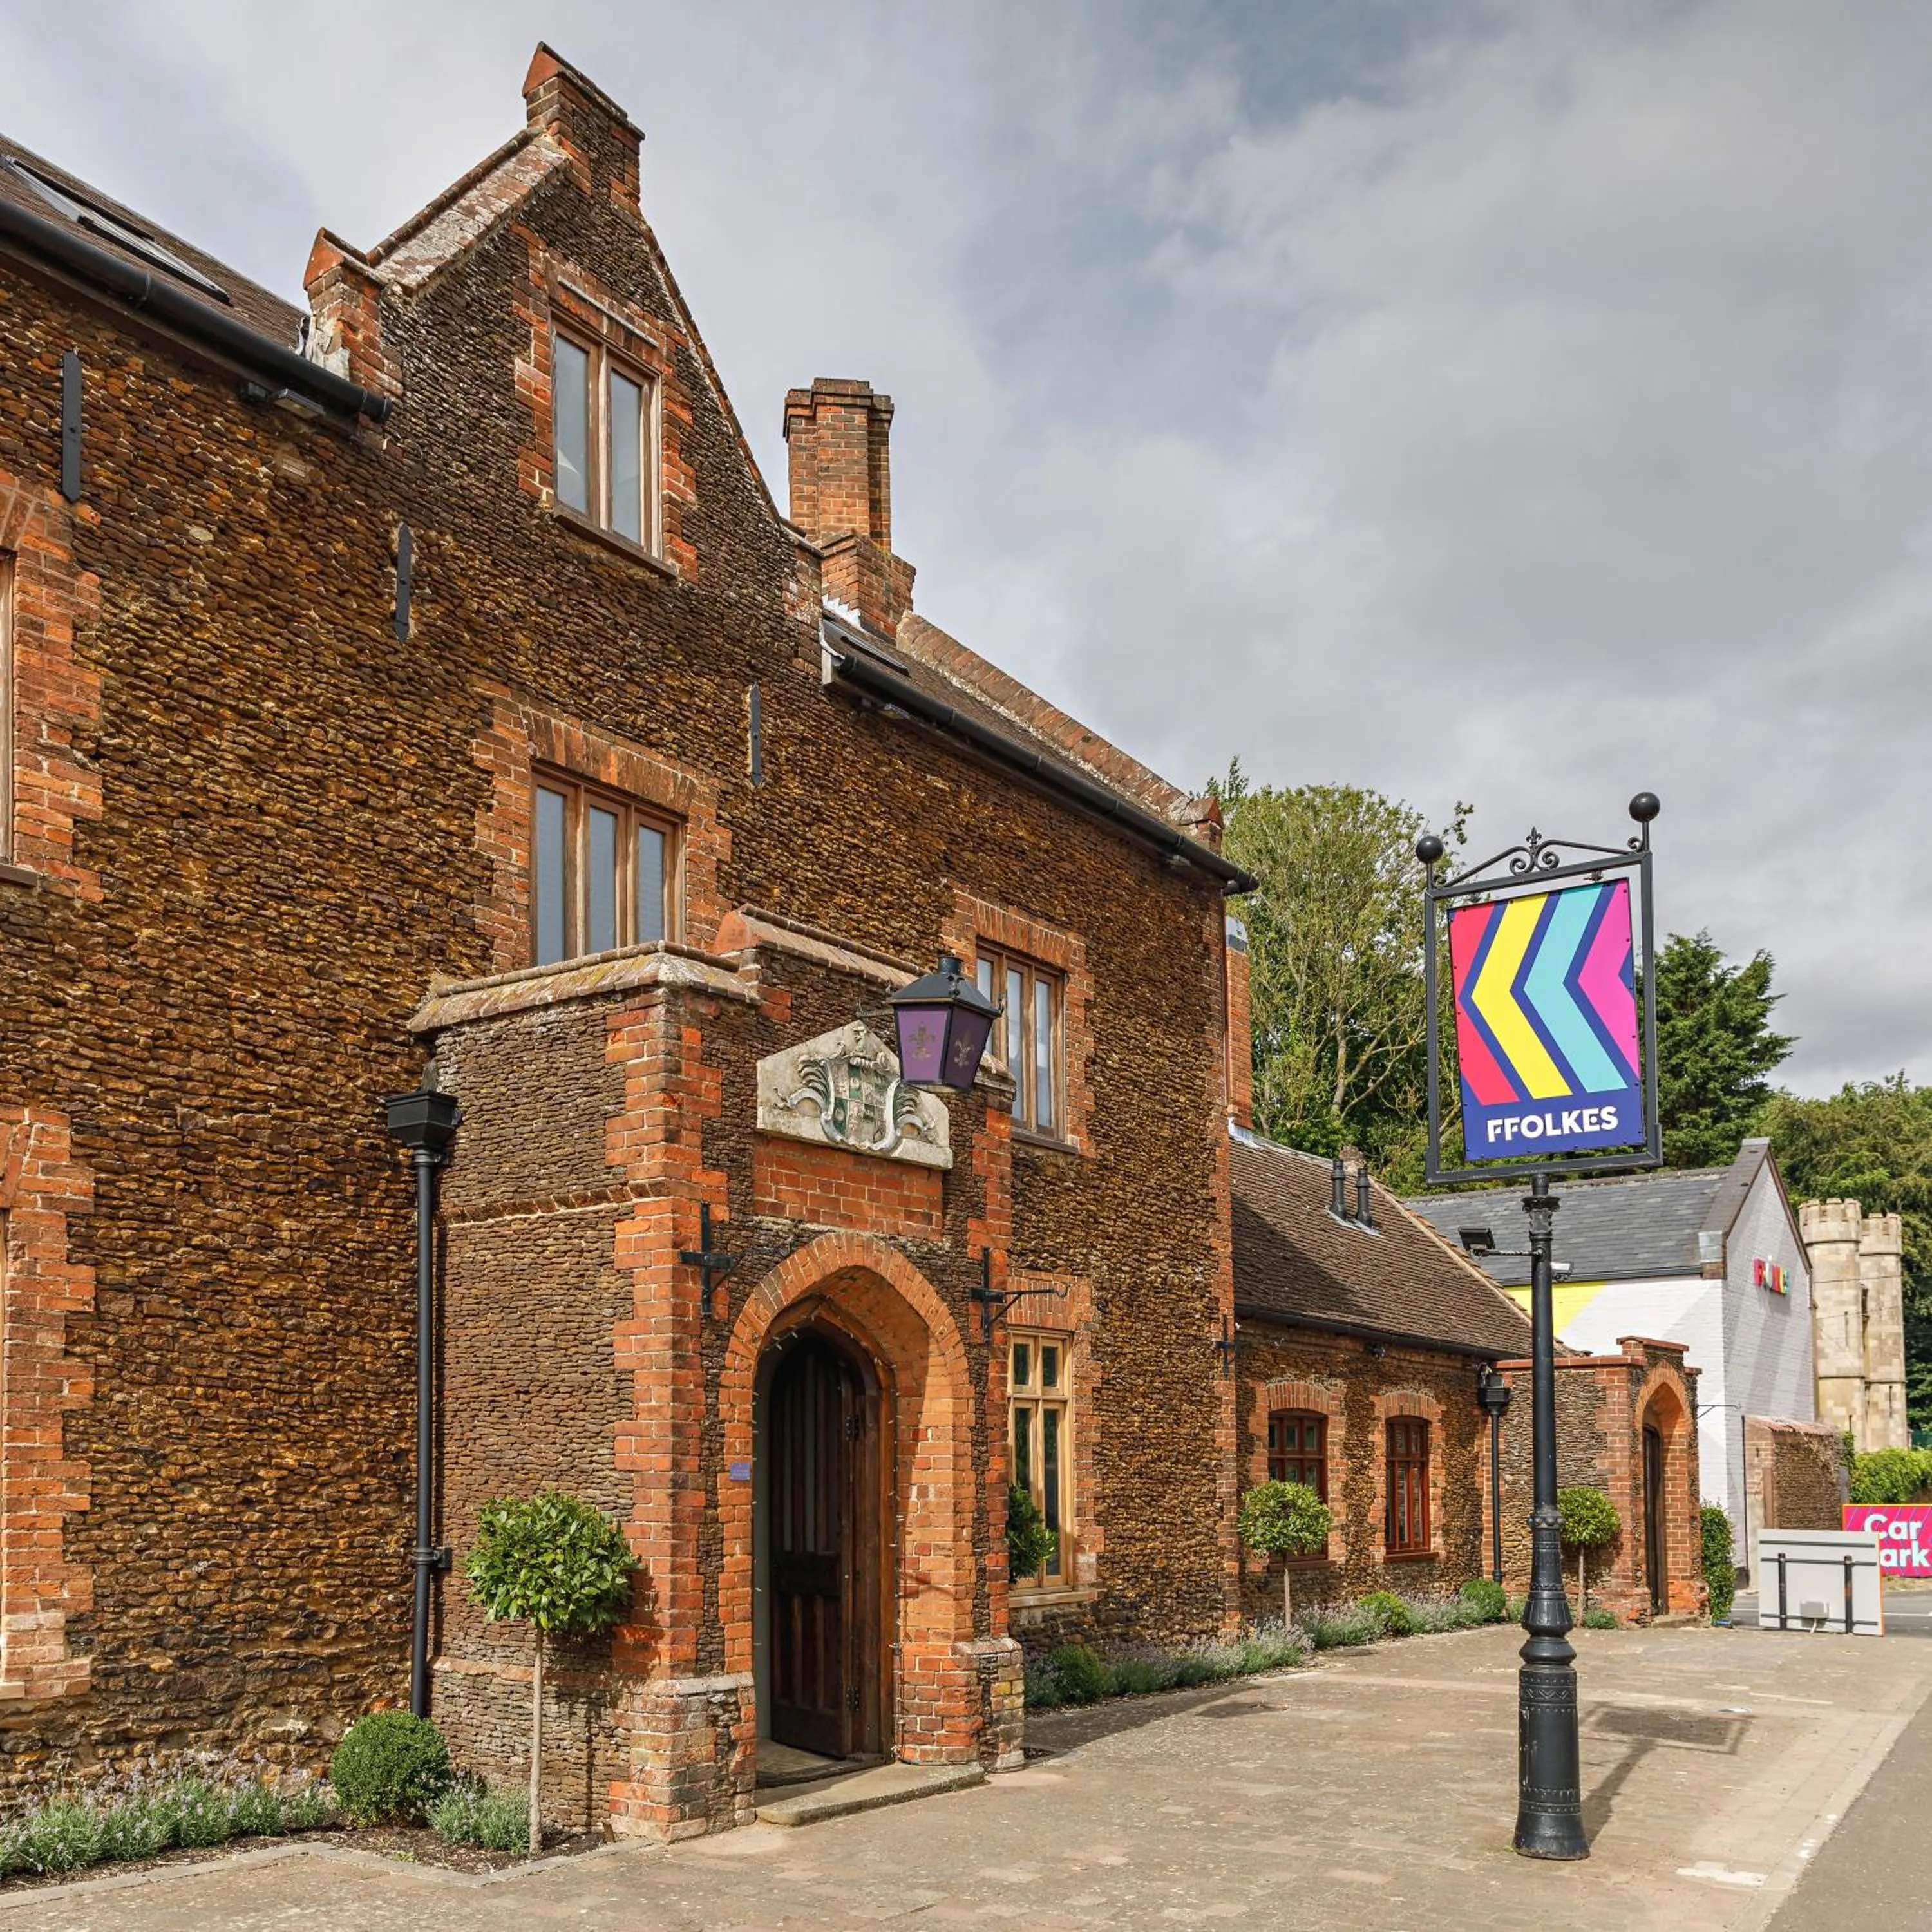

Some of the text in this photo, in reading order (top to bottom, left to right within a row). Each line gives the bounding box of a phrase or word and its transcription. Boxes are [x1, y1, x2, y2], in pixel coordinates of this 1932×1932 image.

[1487, 1106, 1618, 1143] FFOLKES
[1864, 1513, 1922, 1540] Car
[1880, 1540, 1930, 1567] ark
